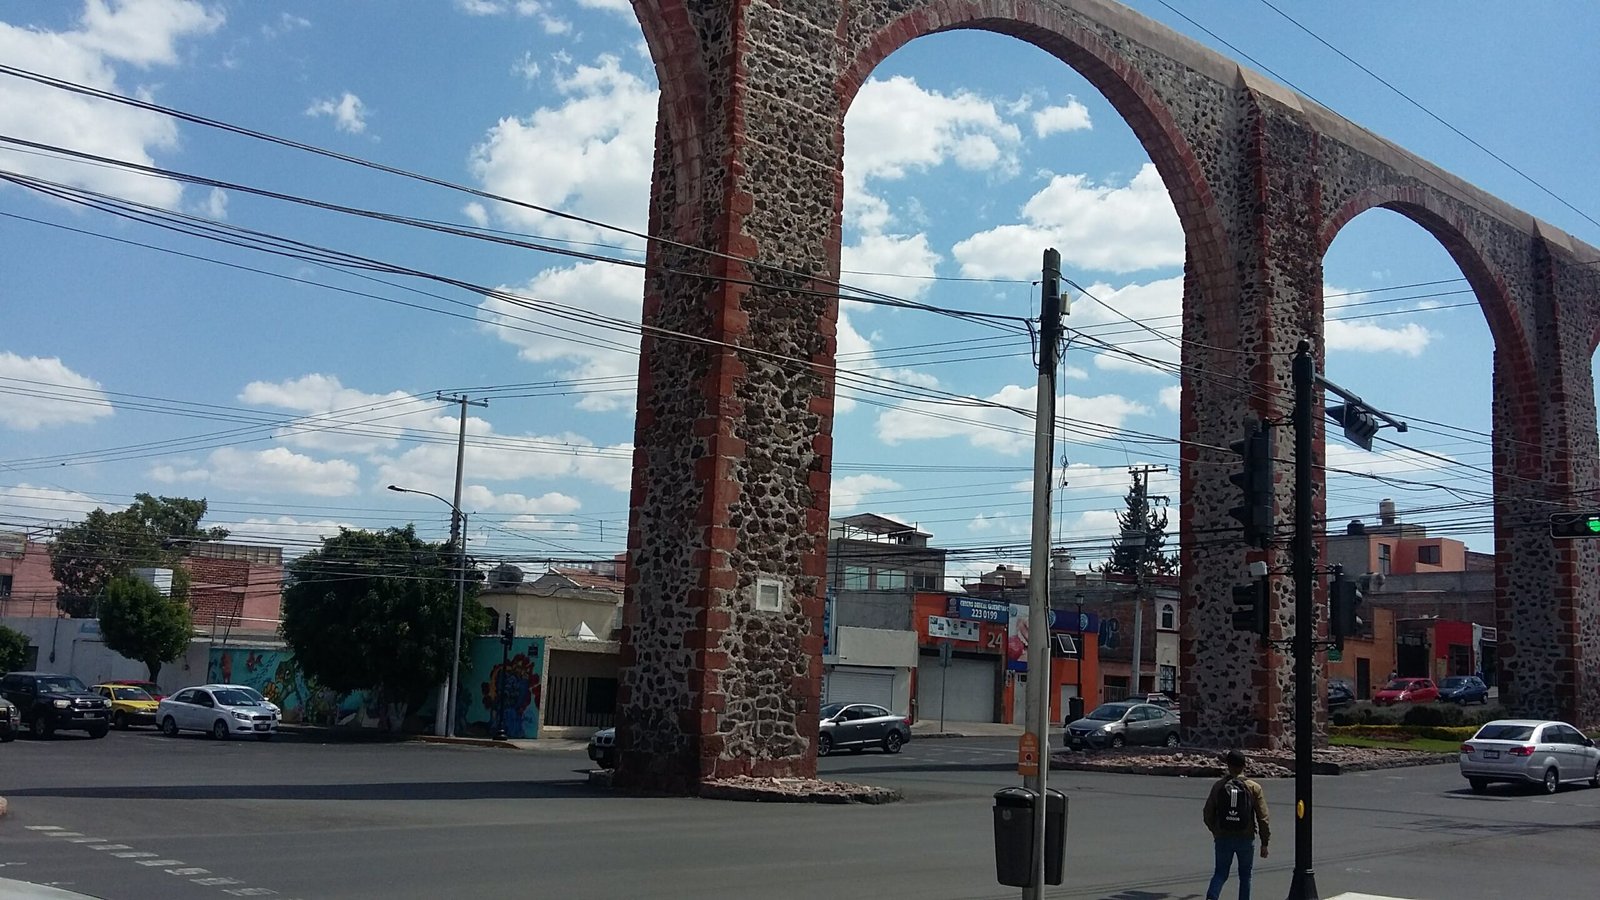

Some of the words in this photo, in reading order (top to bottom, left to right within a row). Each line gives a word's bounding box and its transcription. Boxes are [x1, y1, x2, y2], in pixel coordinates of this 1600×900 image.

[971, 608, 982, 618] 223
[983, 610, 998, 620] 0199
[987, 632, 1003, 649] 24
